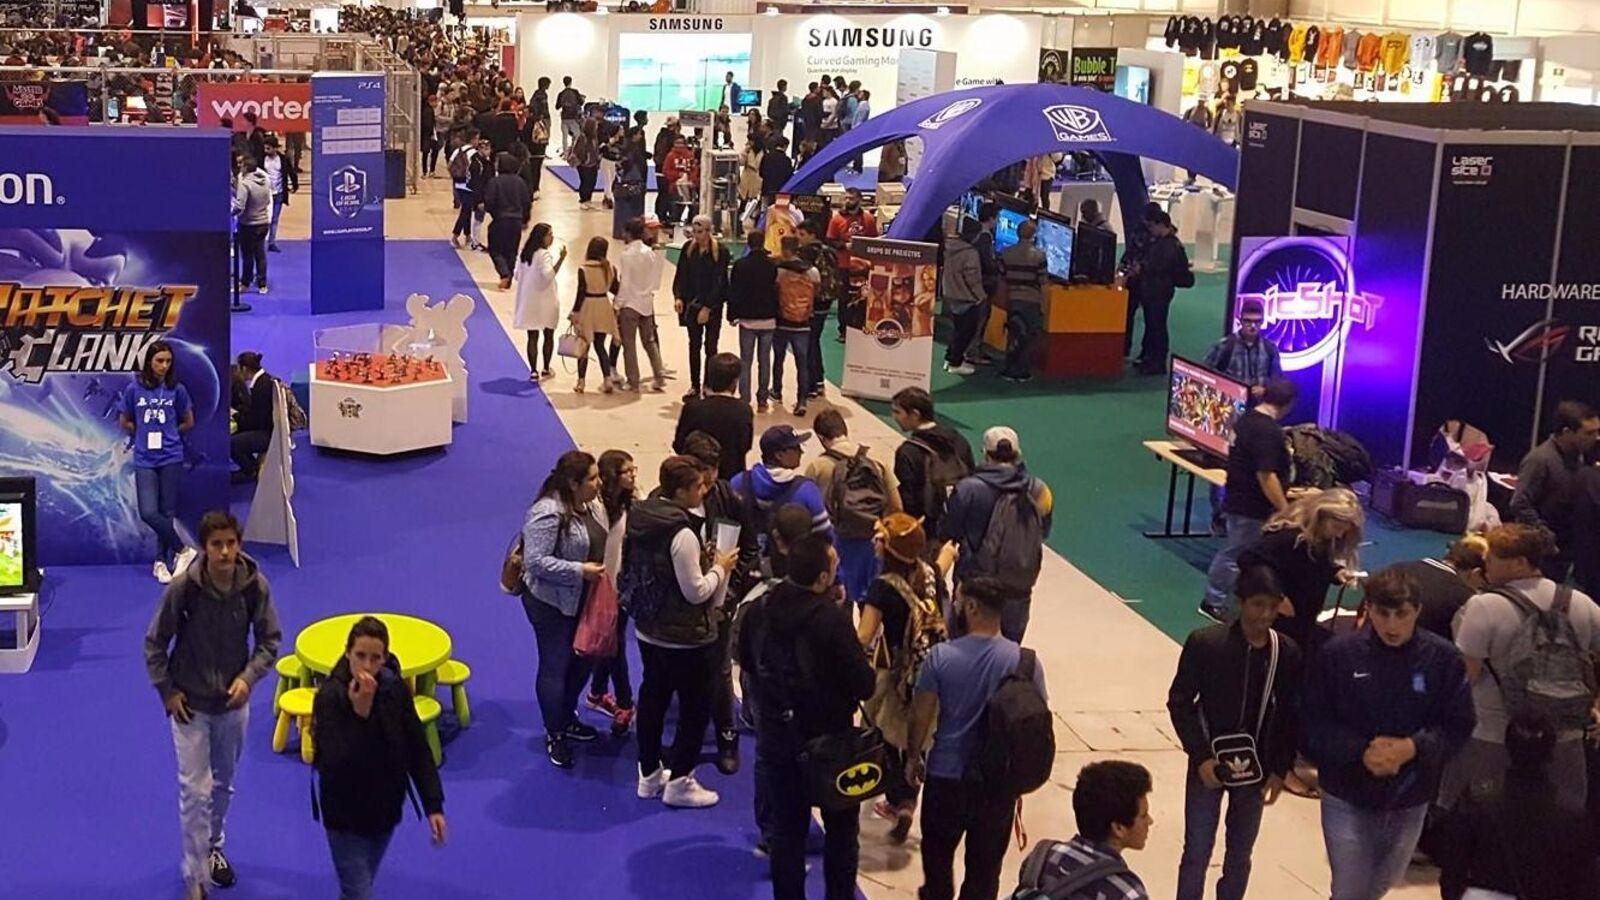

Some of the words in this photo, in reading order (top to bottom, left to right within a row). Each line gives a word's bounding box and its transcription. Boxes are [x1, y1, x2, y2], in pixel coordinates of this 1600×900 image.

[649, 18, 723, 30] SAMSUNG
[808, 28, 933, 48] SAMSUNG
[807, 55, 842, 66] Curved
[843, 55, 879, 68] Gaming
[881, 55, 898, 66] Mo
[1074, 56, 1106, 75] Bubble
[358, 81, 381, 89] PS4
[963, 77, 985, 86] Game
[1051, 107, 1091, 129] WB
[1058, 132, 1108, 142] GAMES
[866, 246, 883, 255] GRUPO
[884, 248, 892, 256] DE
[1501, 283, 1600, 300] HARDWARE
[8, 329, 164, 384] CLANK
[149, 398, 173, 406] PS4
